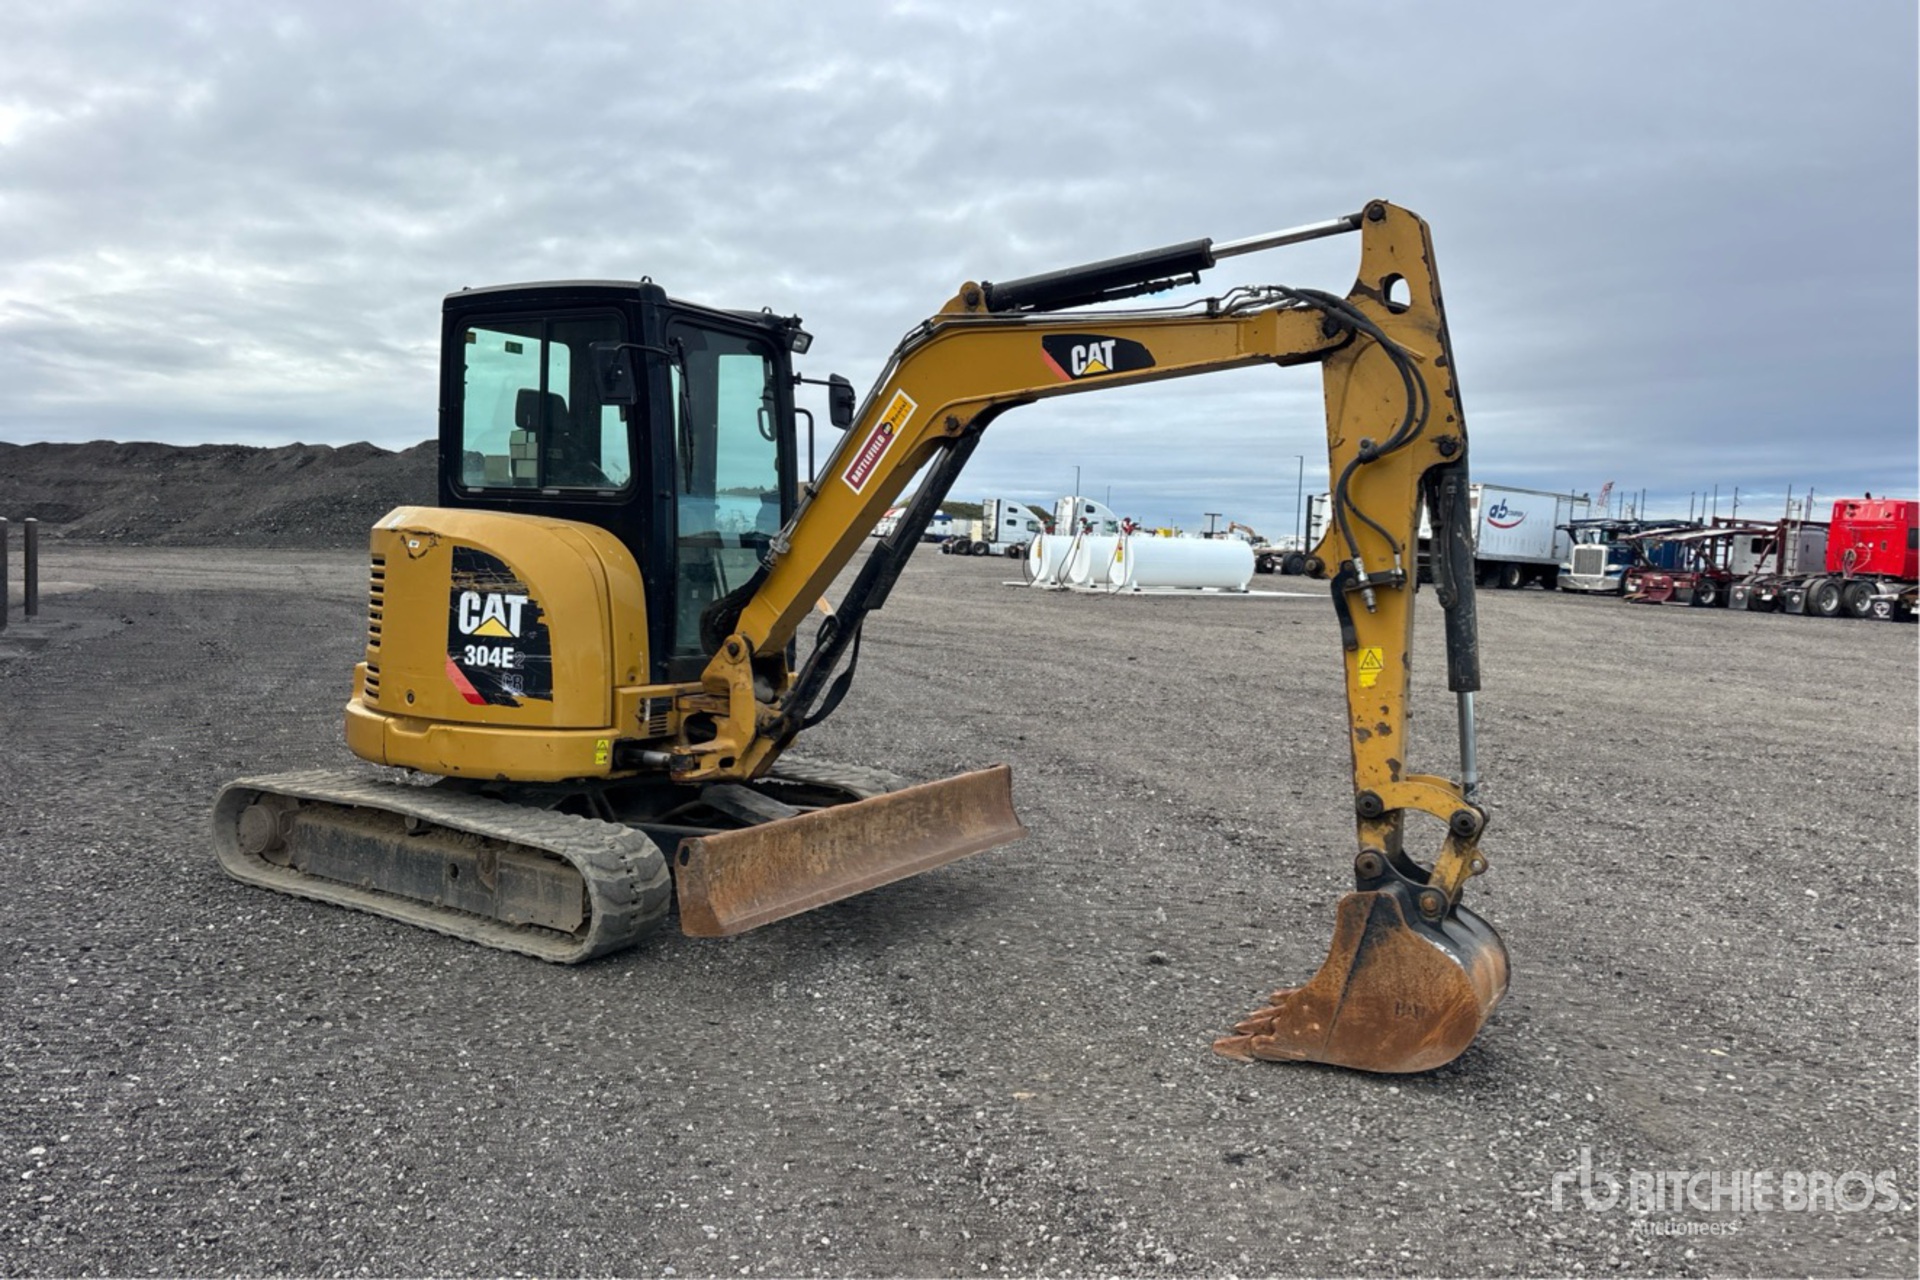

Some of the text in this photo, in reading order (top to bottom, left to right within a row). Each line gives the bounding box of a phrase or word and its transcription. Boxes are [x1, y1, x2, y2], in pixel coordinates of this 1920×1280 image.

[1071, 340, 1116, 376] CAT
[851, 434, 886, 483] BATTLEFIELD
[458, 591, 528, 638] CAT
